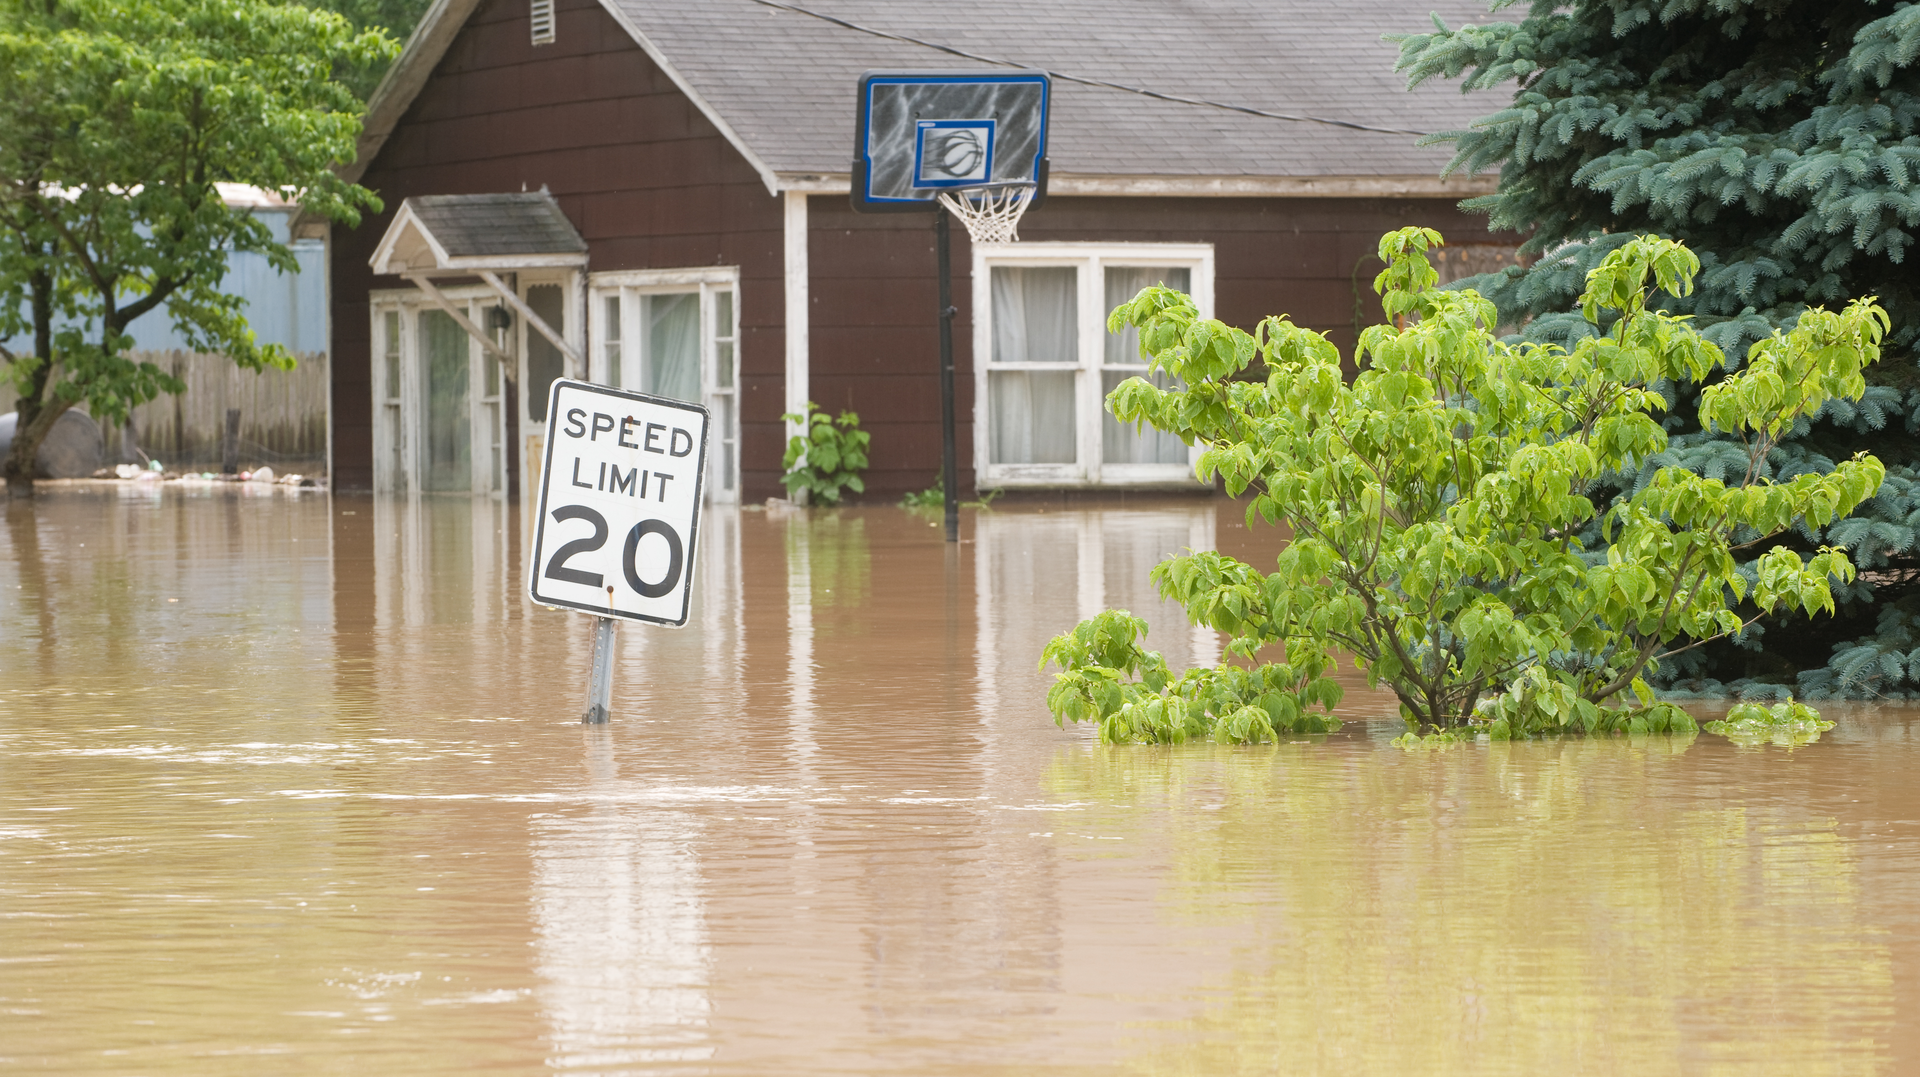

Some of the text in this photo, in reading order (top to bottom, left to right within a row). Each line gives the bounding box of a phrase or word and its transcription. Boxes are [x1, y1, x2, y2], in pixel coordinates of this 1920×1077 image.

[564, 408, 693, 457] SPEED
[572, 457, 674, 502] LIMIT
[544, 505, 683, 598] 20
